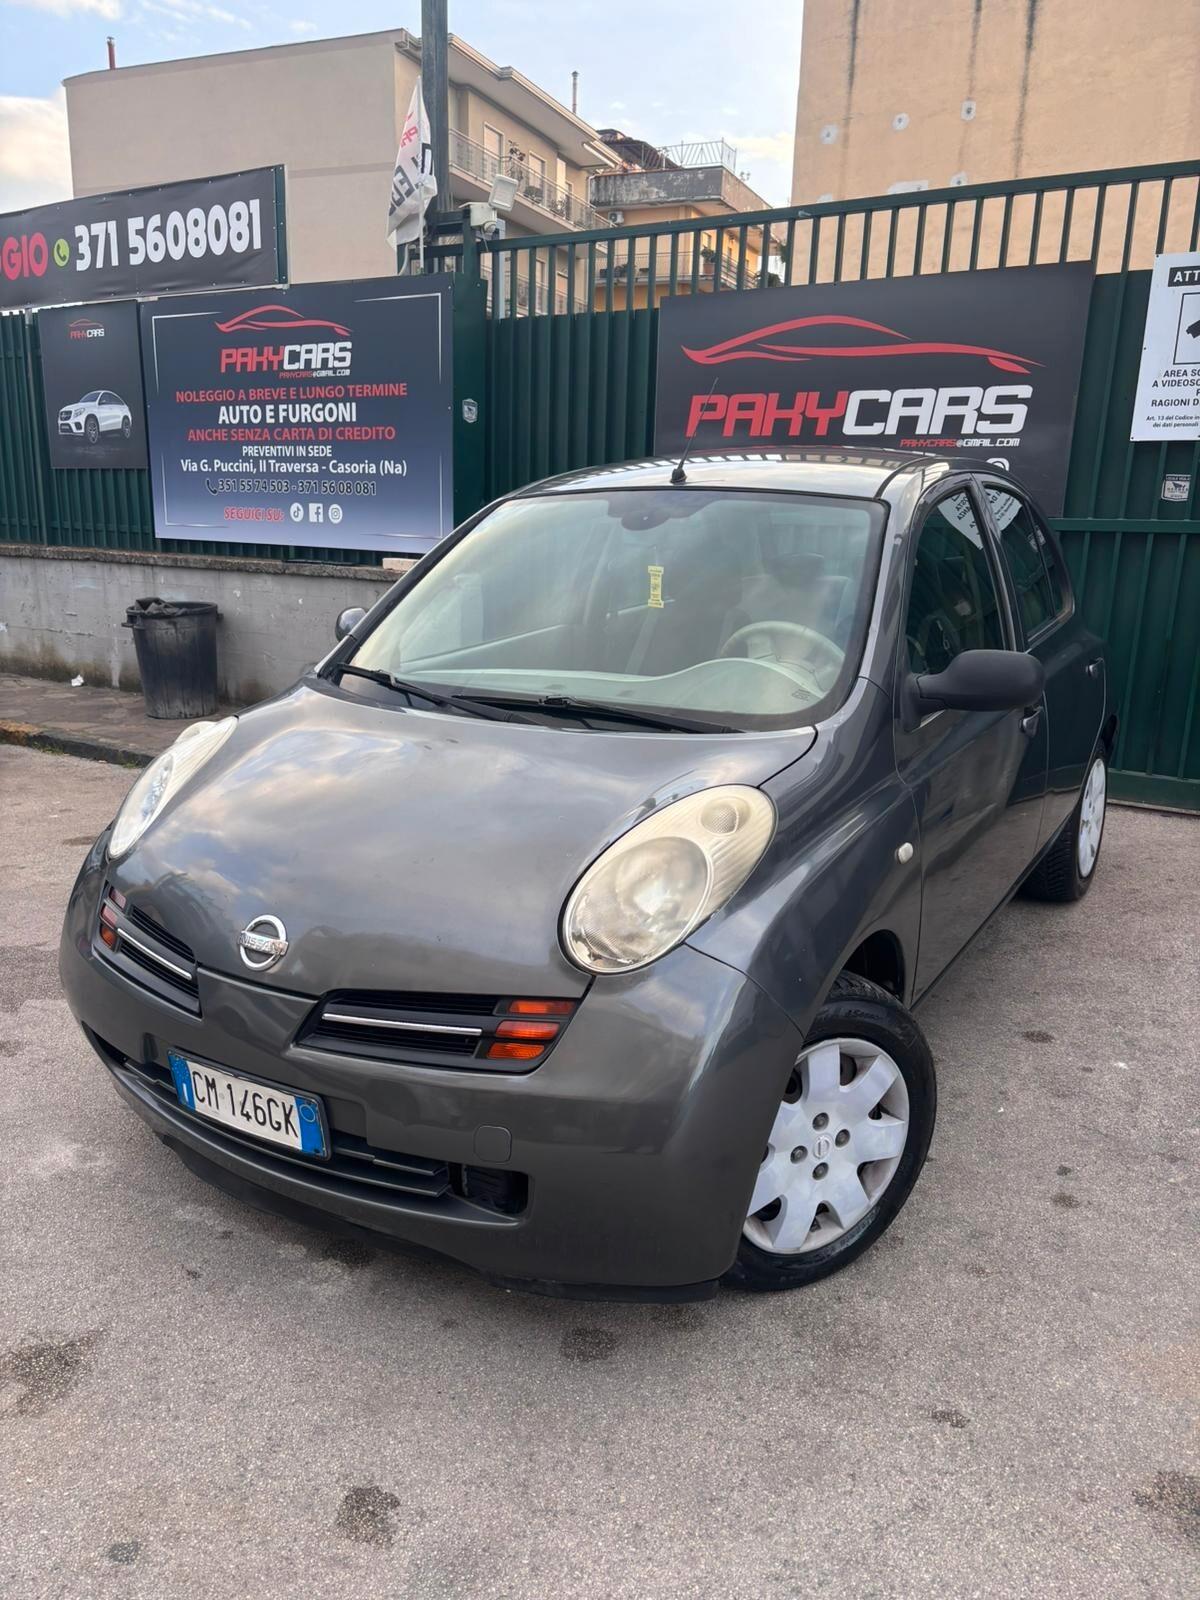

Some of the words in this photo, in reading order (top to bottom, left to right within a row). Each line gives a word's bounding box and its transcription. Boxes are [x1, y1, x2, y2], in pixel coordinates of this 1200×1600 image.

[0, 232, 48, 280] GIO
[74, 220, 119, 271] 371
[127, 198, 262, 265] 5608081
[1173, 270, 1200, 282] ATT
[220, 341, 352, 373] PAKYCARS
[1163, 369, 1188, 378] AREA
[1151, 380, 1159, 388] A
[176, 389, 235, 402] NOLEGGIO
[238, 389, 246, 401] A
[249, 387, 287, 400] BREVE
[290, 387, 297, 399] E
[300, 385, 345, 399] LUNGO
[347, 383, 408, 397] TERMINE
[685, 385, 1034, 437] PAKYCARS
[1151, 399, 1190, 407] RAGIONI
[218, 404, 262, 424] AUTO
[266, 404, 275, 424] E
[279, 402, 357, 423] FURGONI
[188, 428, 229, 441] ANCHE
[231, 428, 271, 441] SENZA
[274, 427, 316, 441] CARTA
[319, 427, 333, 440] DI
[336, 426, 396, 440] CREDITO
[900, 437, 1020, 448] PAKYCARS@GMAIL.COM
[242, 445, 294, 457] PREVENTIVI
[296, 445, 306, 457] IN
[308, 445, 333, 457] SEDE
[180, 459, 198, 472] Via
[200, 459, 212, 472] G.
[214, 459, 257, 474] Puccini,
[268, 460, 319, 473] Traversa
[329, 460, 377, 474] Casoria
[380, 459, 407, 477] (Na)
[219, 479, 237, 492] 351
[240, 479, 252, 492] 55
[254, 480, 268, 493] 74
[270, 480, 290, 493] 503
[298, 480, 319, 494] 371
[321, 480, 336, 495] 56
[338, 481, 353, 495] 08
[355, 481, 377, 496] 081
[224, 506, 264, 520] SEGUICI
[192, 1071, 219, 1110] CM
[226, 1083, 298, 1138] 146GK
